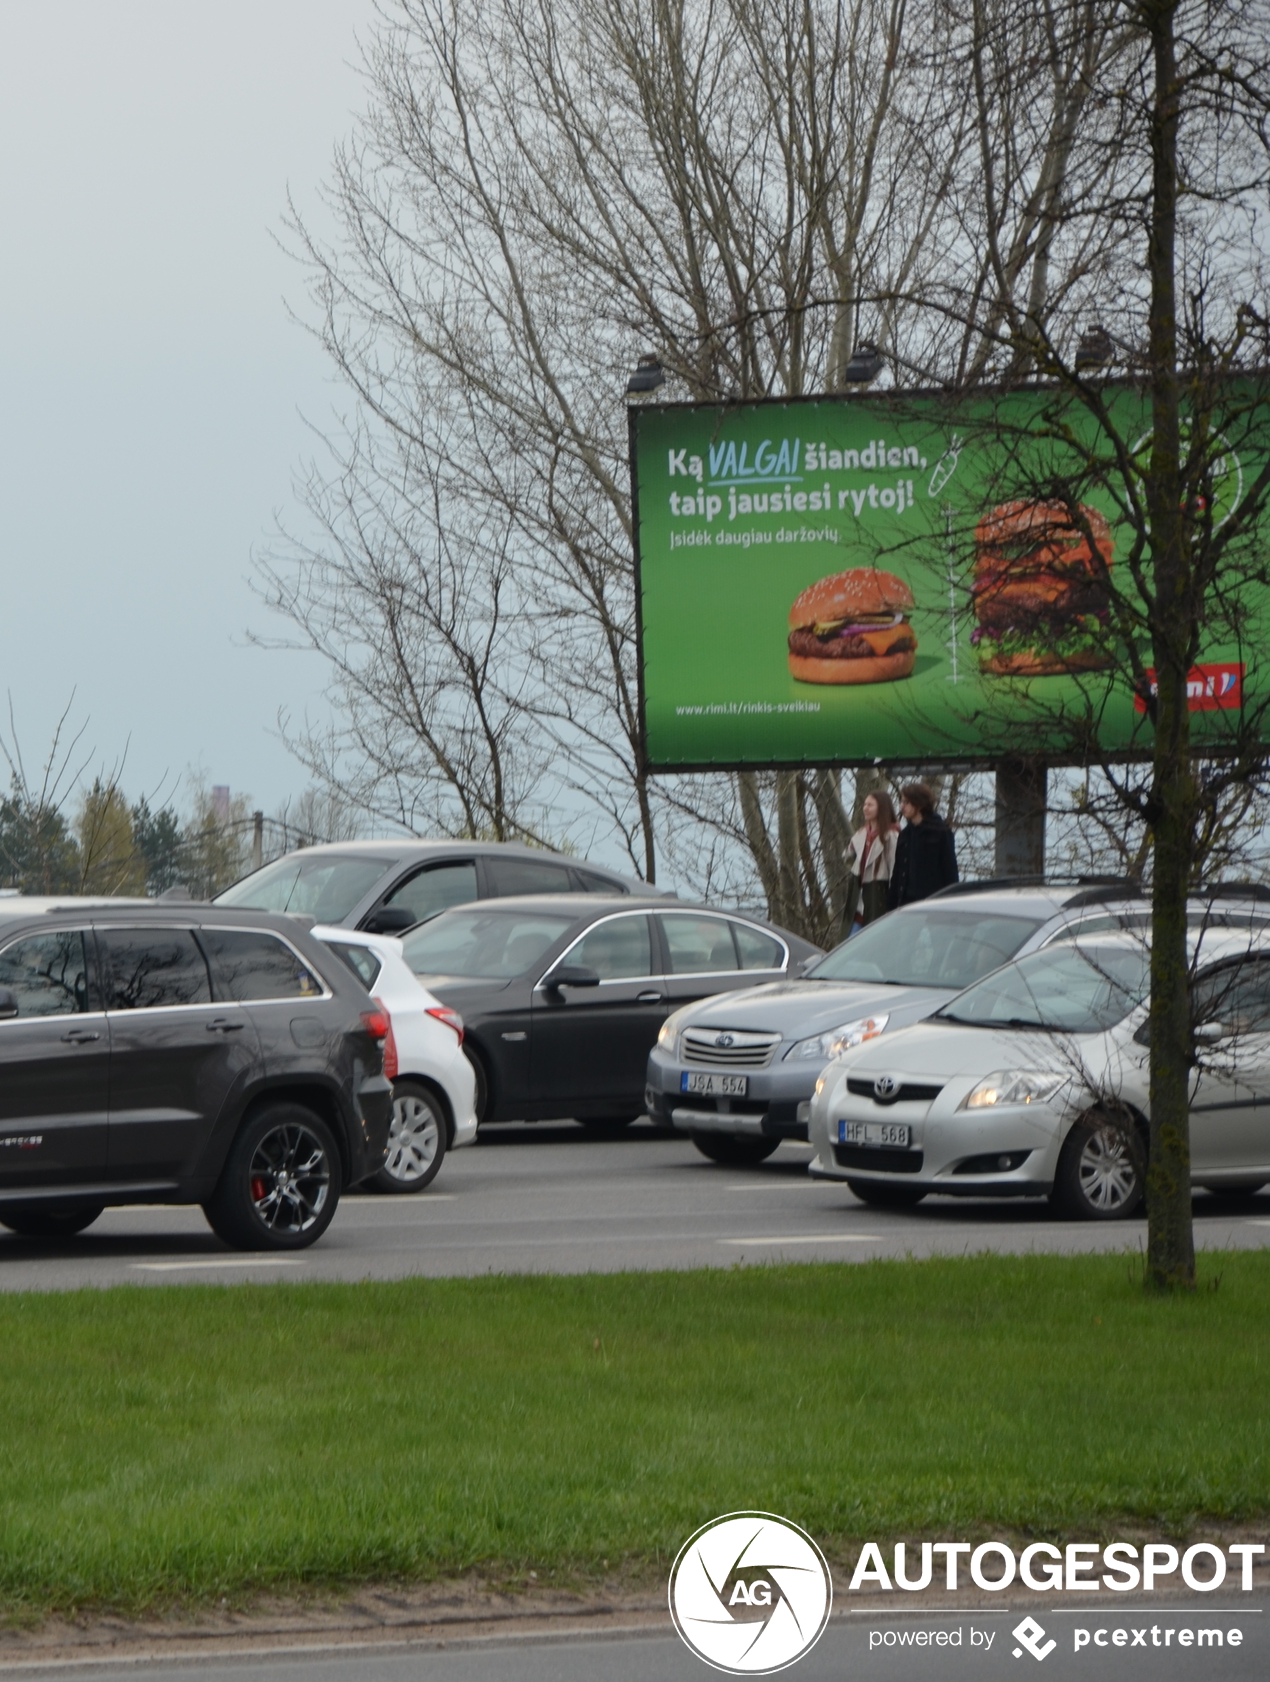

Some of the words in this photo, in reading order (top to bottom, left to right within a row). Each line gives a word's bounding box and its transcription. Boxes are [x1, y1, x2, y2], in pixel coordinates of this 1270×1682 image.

[668, 448, 703, 483] Ką
[709, 437, 800, 478] VALGAI
[804, 439, 928, 472] šiandien,
[669, 487, 722, 522] taip
[728, 482, 831, 521] jausiesi
[838, 479, 914, 517] rytoj!
[670, 529, 712, 551] Įsidėk
[715, 527, 772, 549] daugiau
[675, 700, 821, 716] www.rimi.lt/rinkis-sveikiau
[846, 1123, 872, 1142] HFL
[881, 1125, 906, 1143] 568
